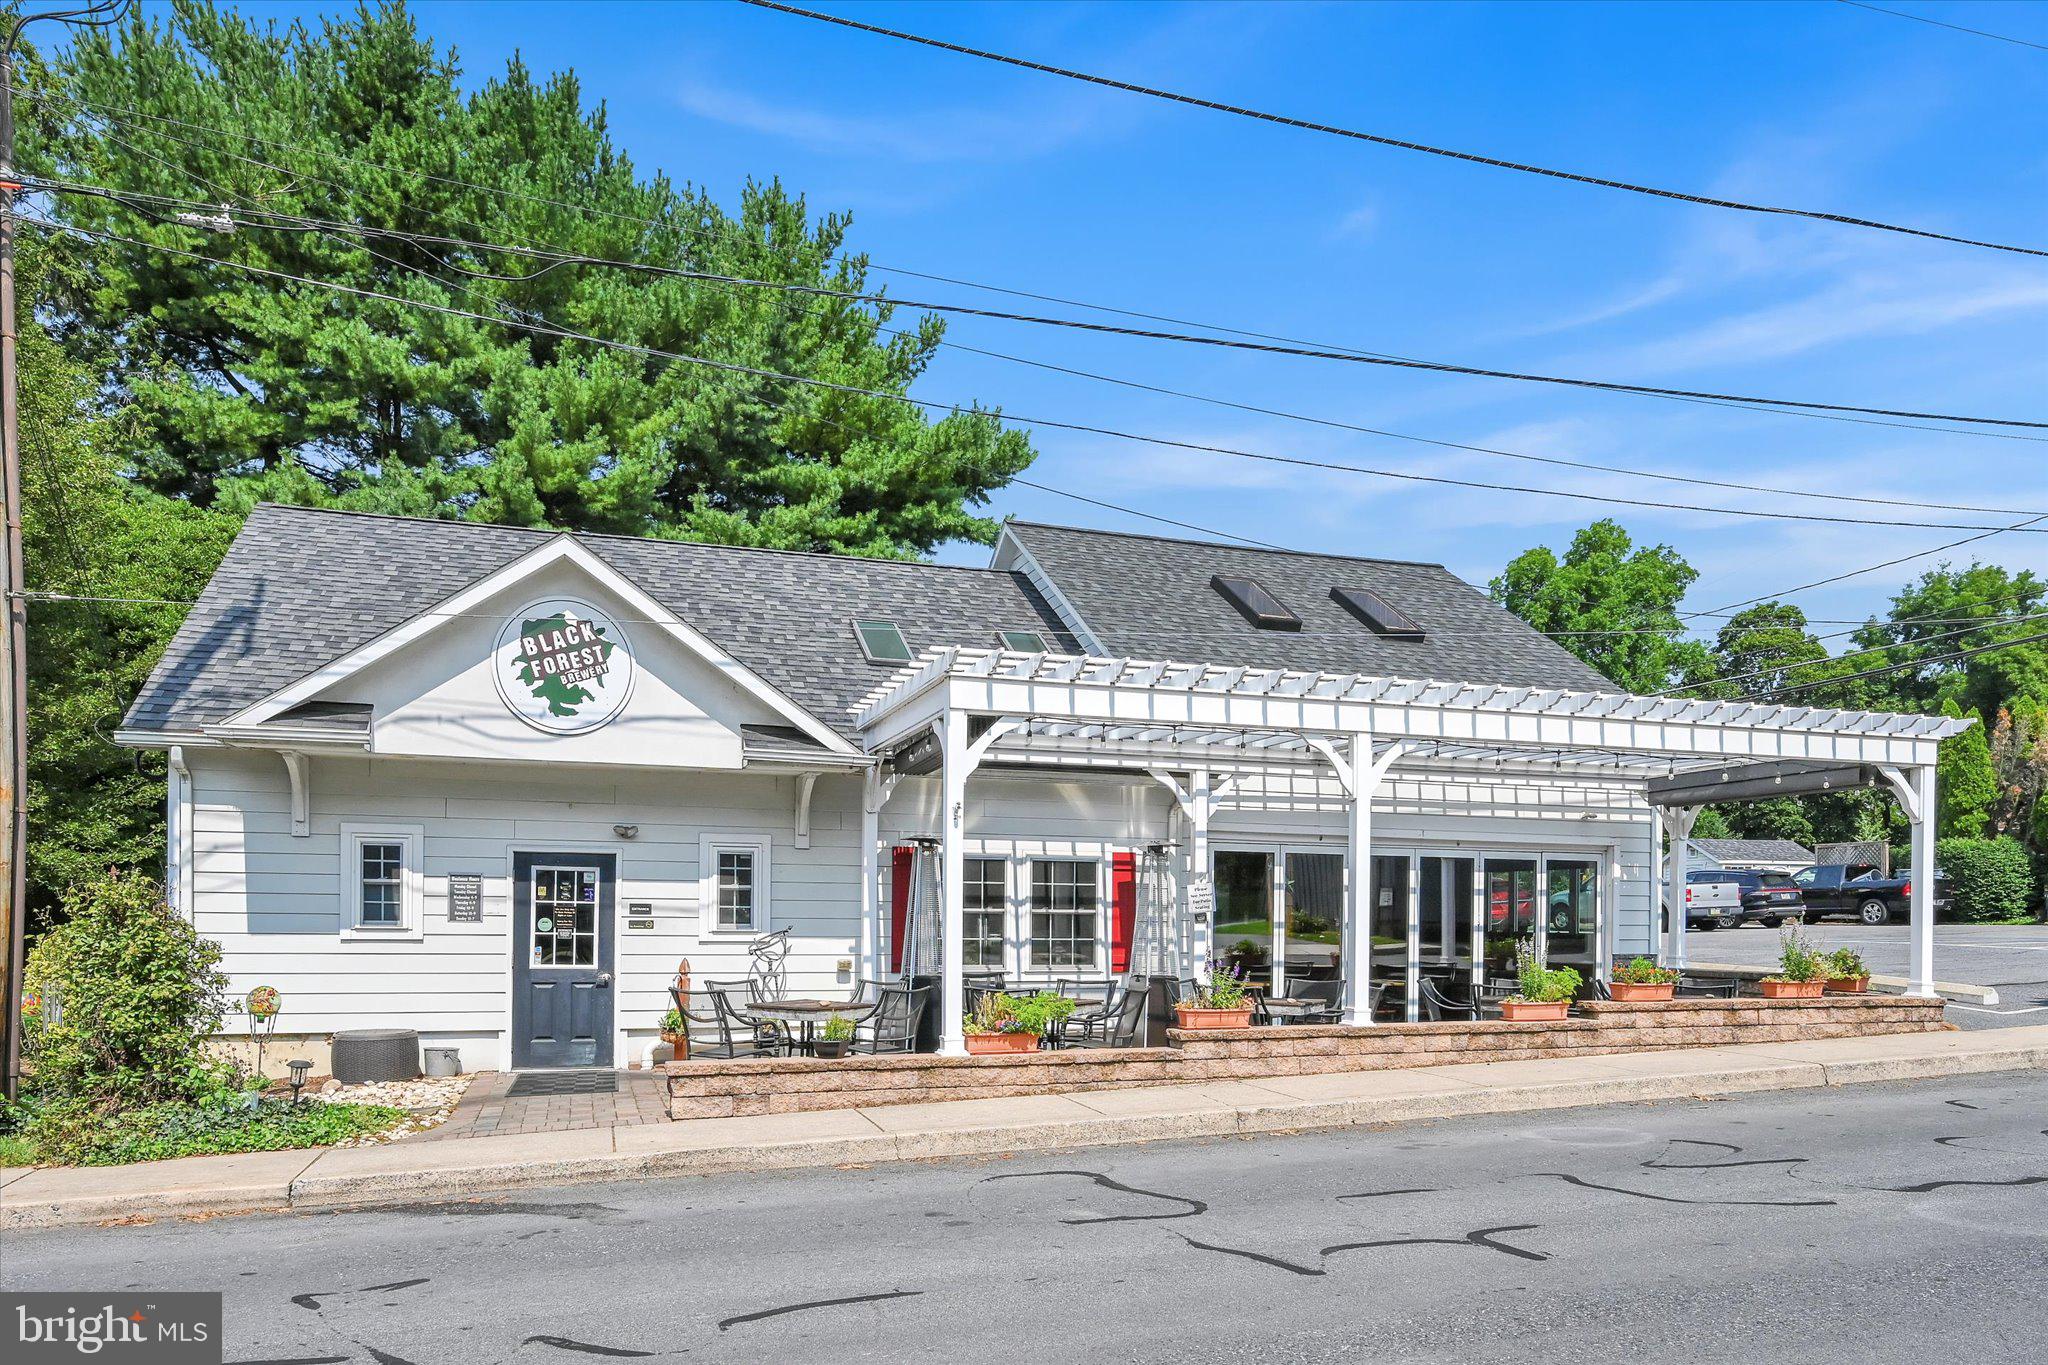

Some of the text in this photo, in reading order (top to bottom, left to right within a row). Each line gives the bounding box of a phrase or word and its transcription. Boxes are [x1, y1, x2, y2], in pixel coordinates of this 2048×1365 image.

[522, 622, 597, 657] BLACK
[530, 645, 605, 678] FOREST
[560, 663, 609, 685] BREWERY
